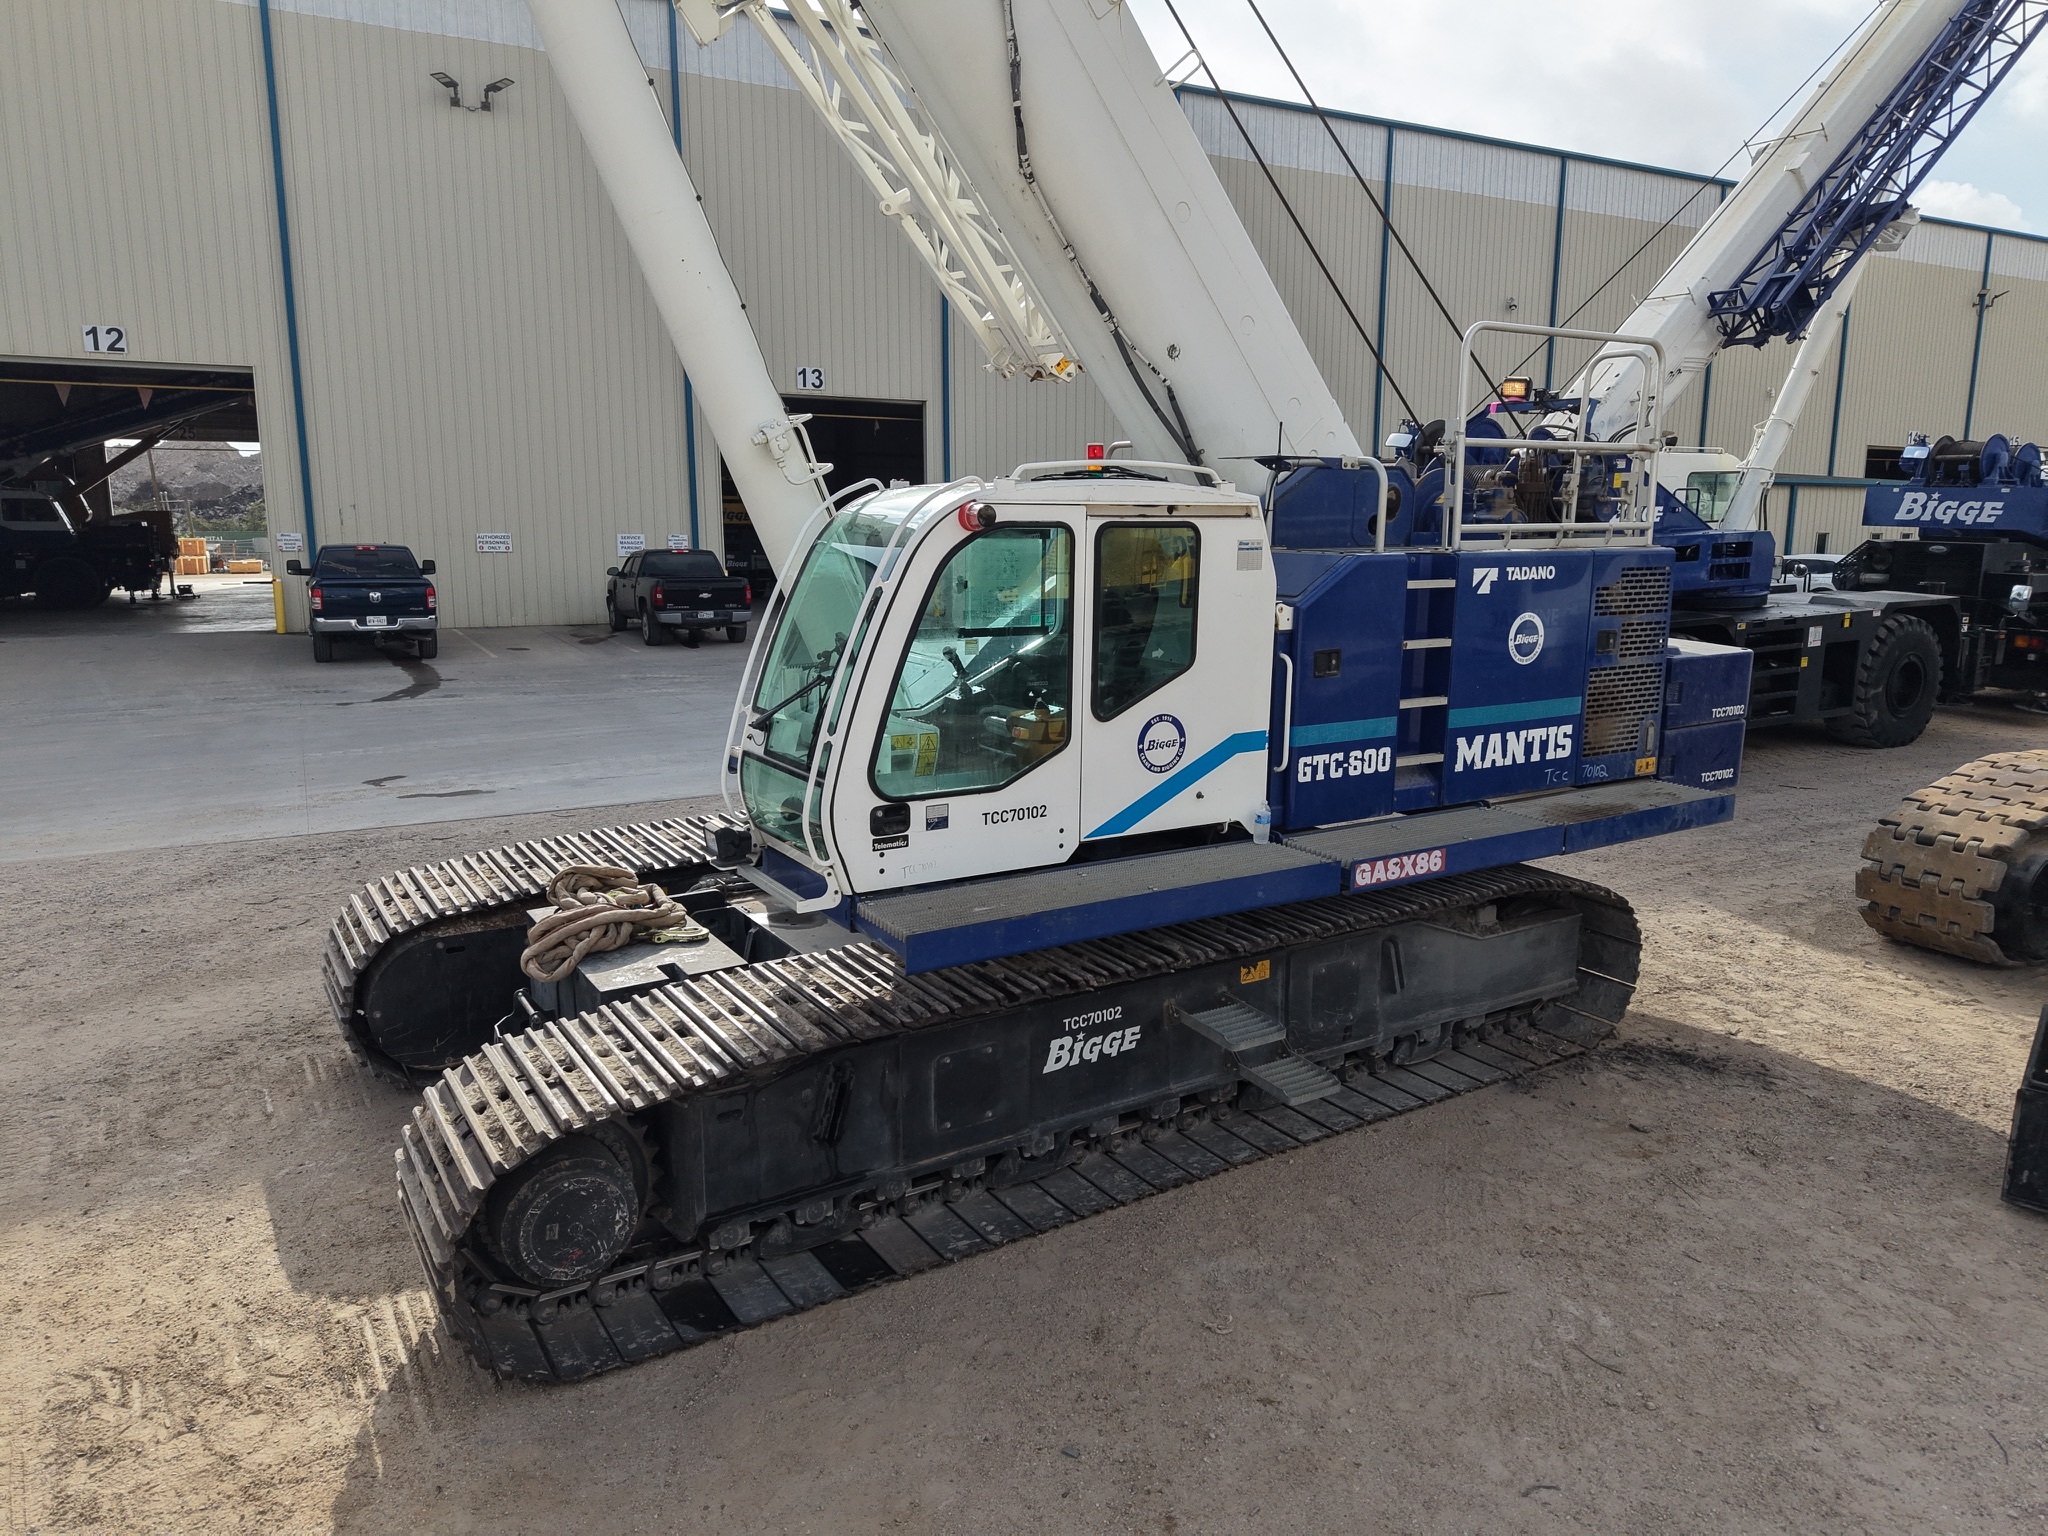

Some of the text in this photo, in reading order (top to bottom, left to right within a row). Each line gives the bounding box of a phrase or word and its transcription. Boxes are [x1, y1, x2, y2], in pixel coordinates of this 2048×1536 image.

[85, 326, 125, 352] 12
[798, 368, 823, 389] 13
[1506, 565, 1556, 581] TADANO
[1712, 704, 1745, 718] TCC70102
[1454, 724, 1573, 772] MANTIS
[1298, 746, 1392, 783] GTC-600
[1701, 768, 1734, 782] TCC70102
[982, 804, 1047, 825] TCC70102
[873, 839, 907, 850] Telematics
[1355, 849, 1443, 886] GA8X86
[1063, 1006, 1122, 1031] TCC70102
